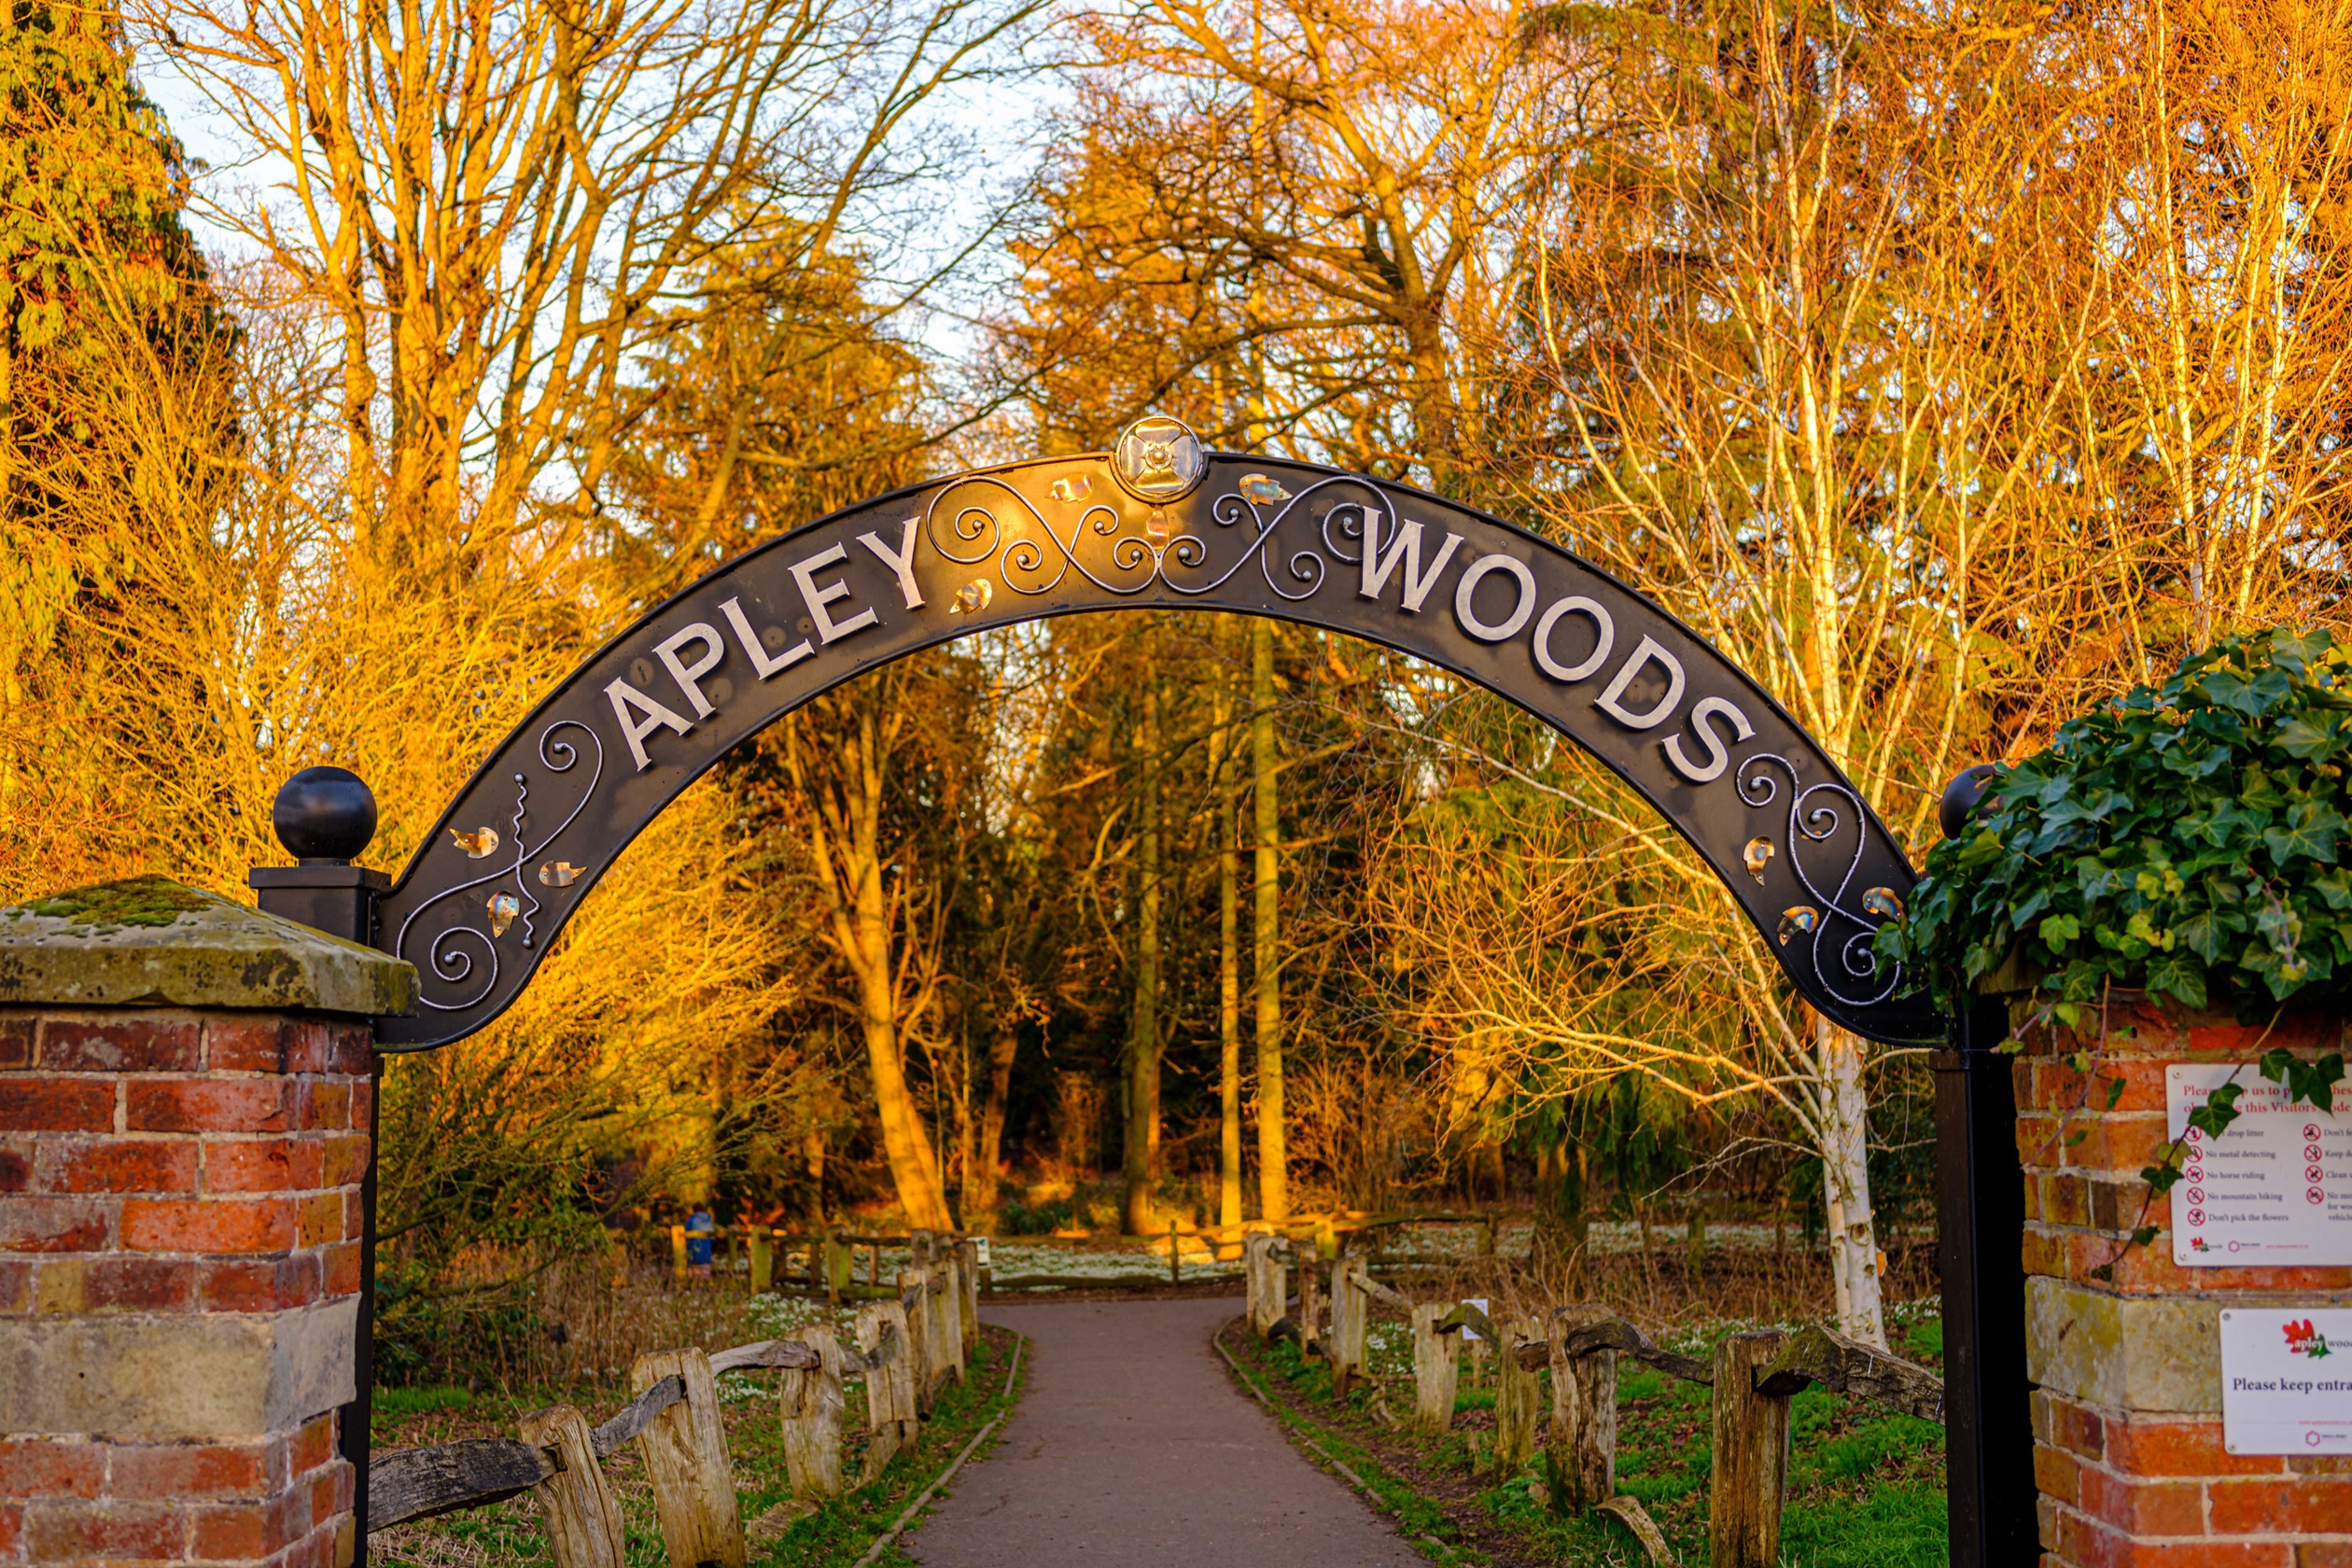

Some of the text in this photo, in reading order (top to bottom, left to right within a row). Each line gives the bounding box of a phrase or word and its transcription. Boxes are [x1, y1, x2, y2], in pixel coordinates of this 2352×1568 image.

[603, 505, 1757, 783] APLEY WOODS
[2183, 1085, 2215, 1097] Plea
[2251, 1086, 2265, 1096] us
[2268, 1085, 2280, 1096] to
[2245, 1101, 2268, 1113] this
[2271, 1101, 2317, 1113] Visitors
[2226, 1129, 2246, 1139] drop
[2246, 1128, 2264, 1138] litter
[2205, 1150, 2276, 1160] No metal detecting
[2325, 1149, 2345, 1160] Keep
[2206, 1171, 2265, 1182] No horse riding
[2325, 1170, 2347, 1179] Clean
[2259, 1192, 2283, 1203] biking
[2327, 1192, 2339, 1200] No
[2328, 1202, 2338, 1211] for
[2208, 1213, 2289, 1224] Don't pick the flowers
[2293, 1336, 2352, 1351] apley woo
[2232, 1377, 2352, 1394] Please keep entra
